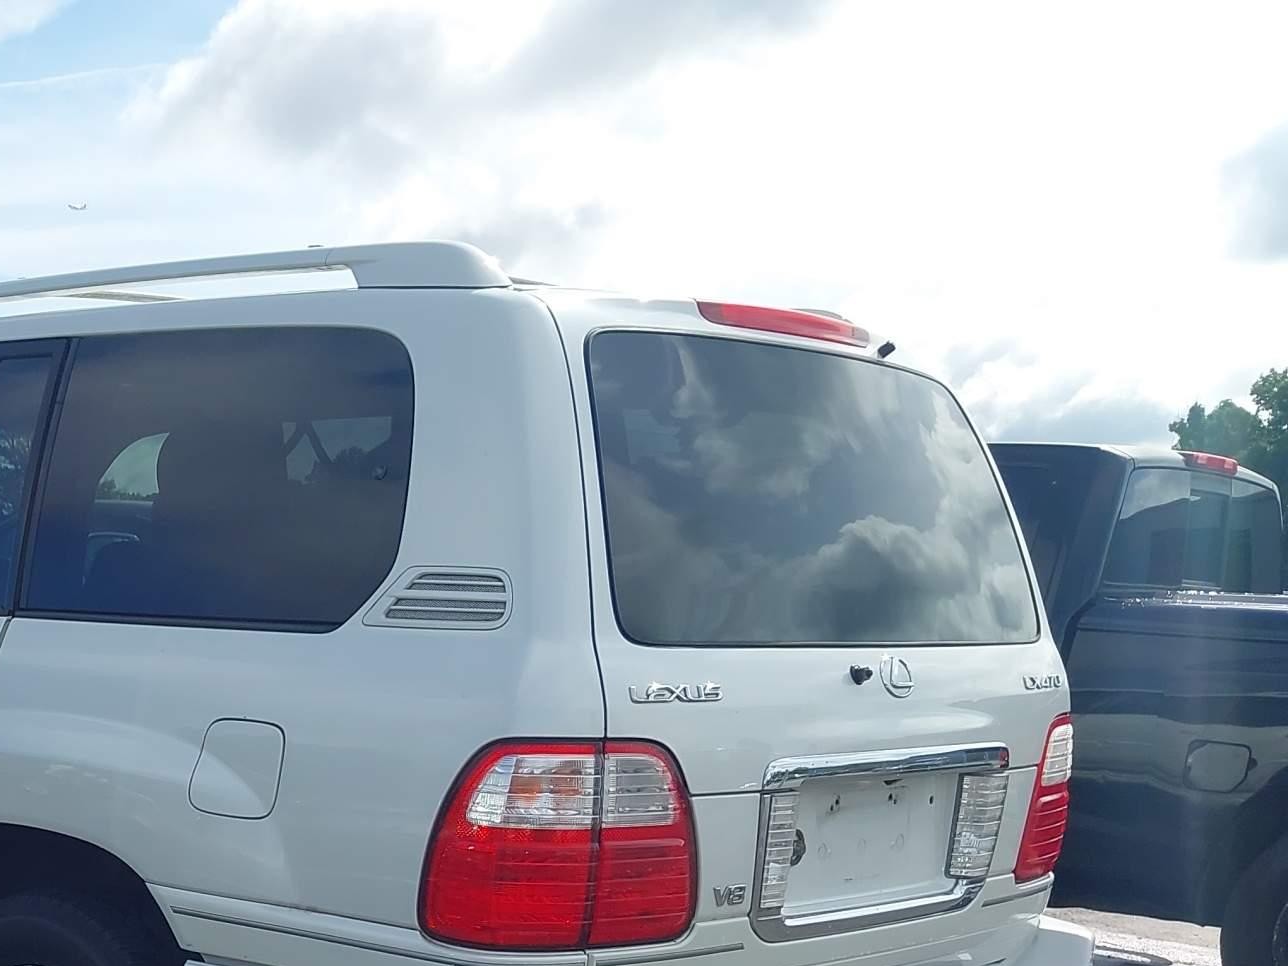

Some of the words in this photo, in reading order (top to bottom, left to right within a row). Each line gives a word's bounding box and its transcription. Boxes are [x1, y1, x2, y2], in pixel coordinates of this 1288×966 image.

[1022, 673, 1062, 690] LX470
[628, 682, 723, 704] LEXUS
[712, 884, 747, 907] V8
